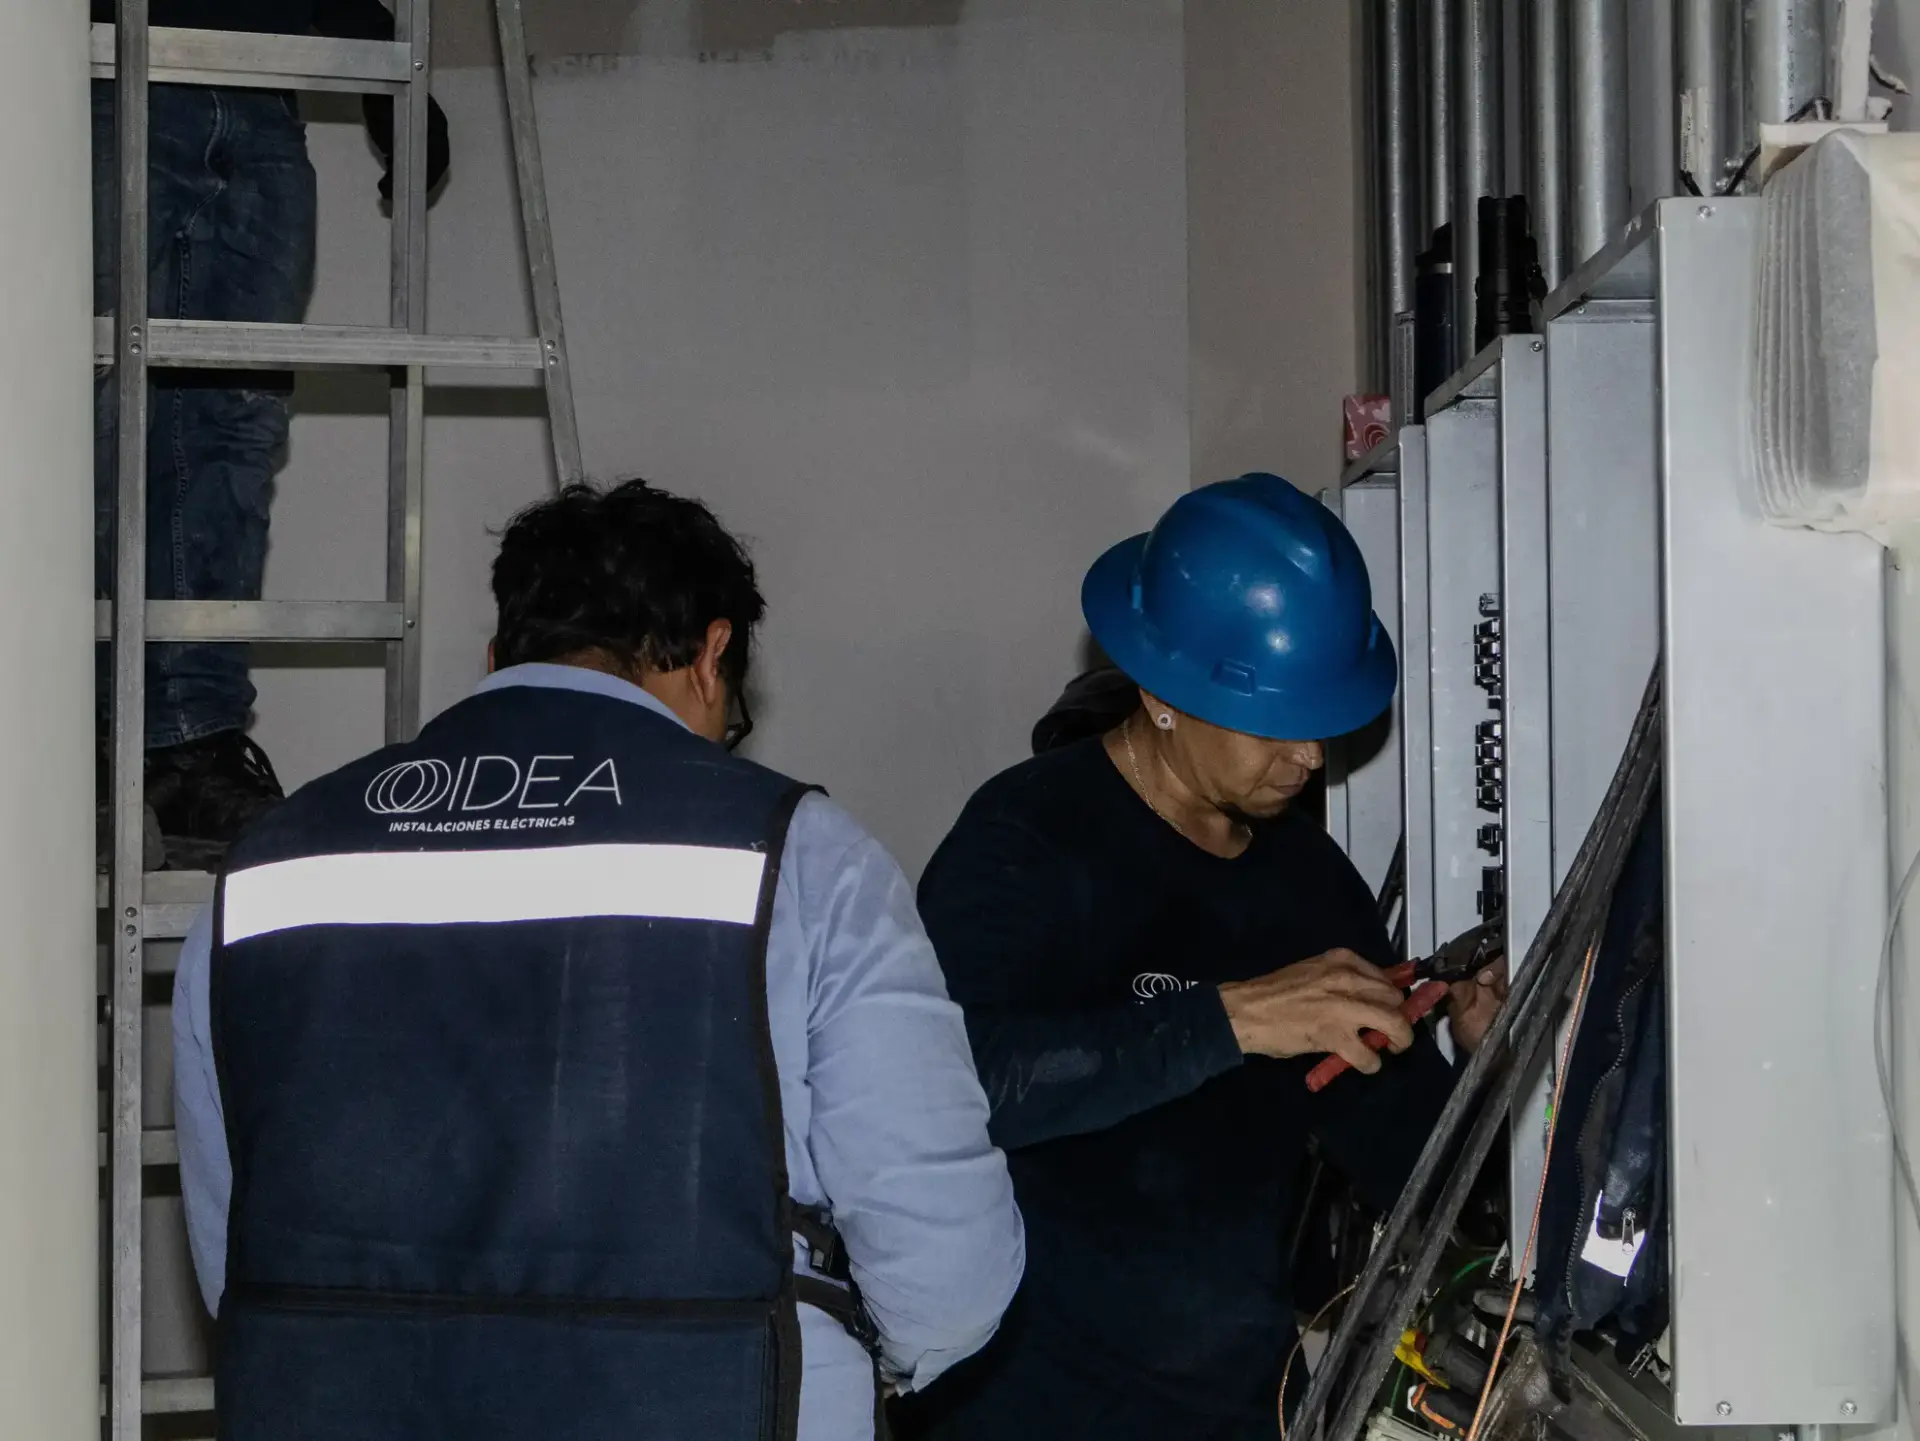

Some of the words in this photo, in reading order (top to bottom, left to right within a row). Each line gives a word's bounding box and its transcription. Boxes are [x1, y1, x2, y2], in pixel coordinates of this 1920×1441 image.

[447, 755, 622, 811] IDEA
[388, 819, 491, 833] INSTALACIONES
[493, 815, 576, 830] ELÉCTRICAS
